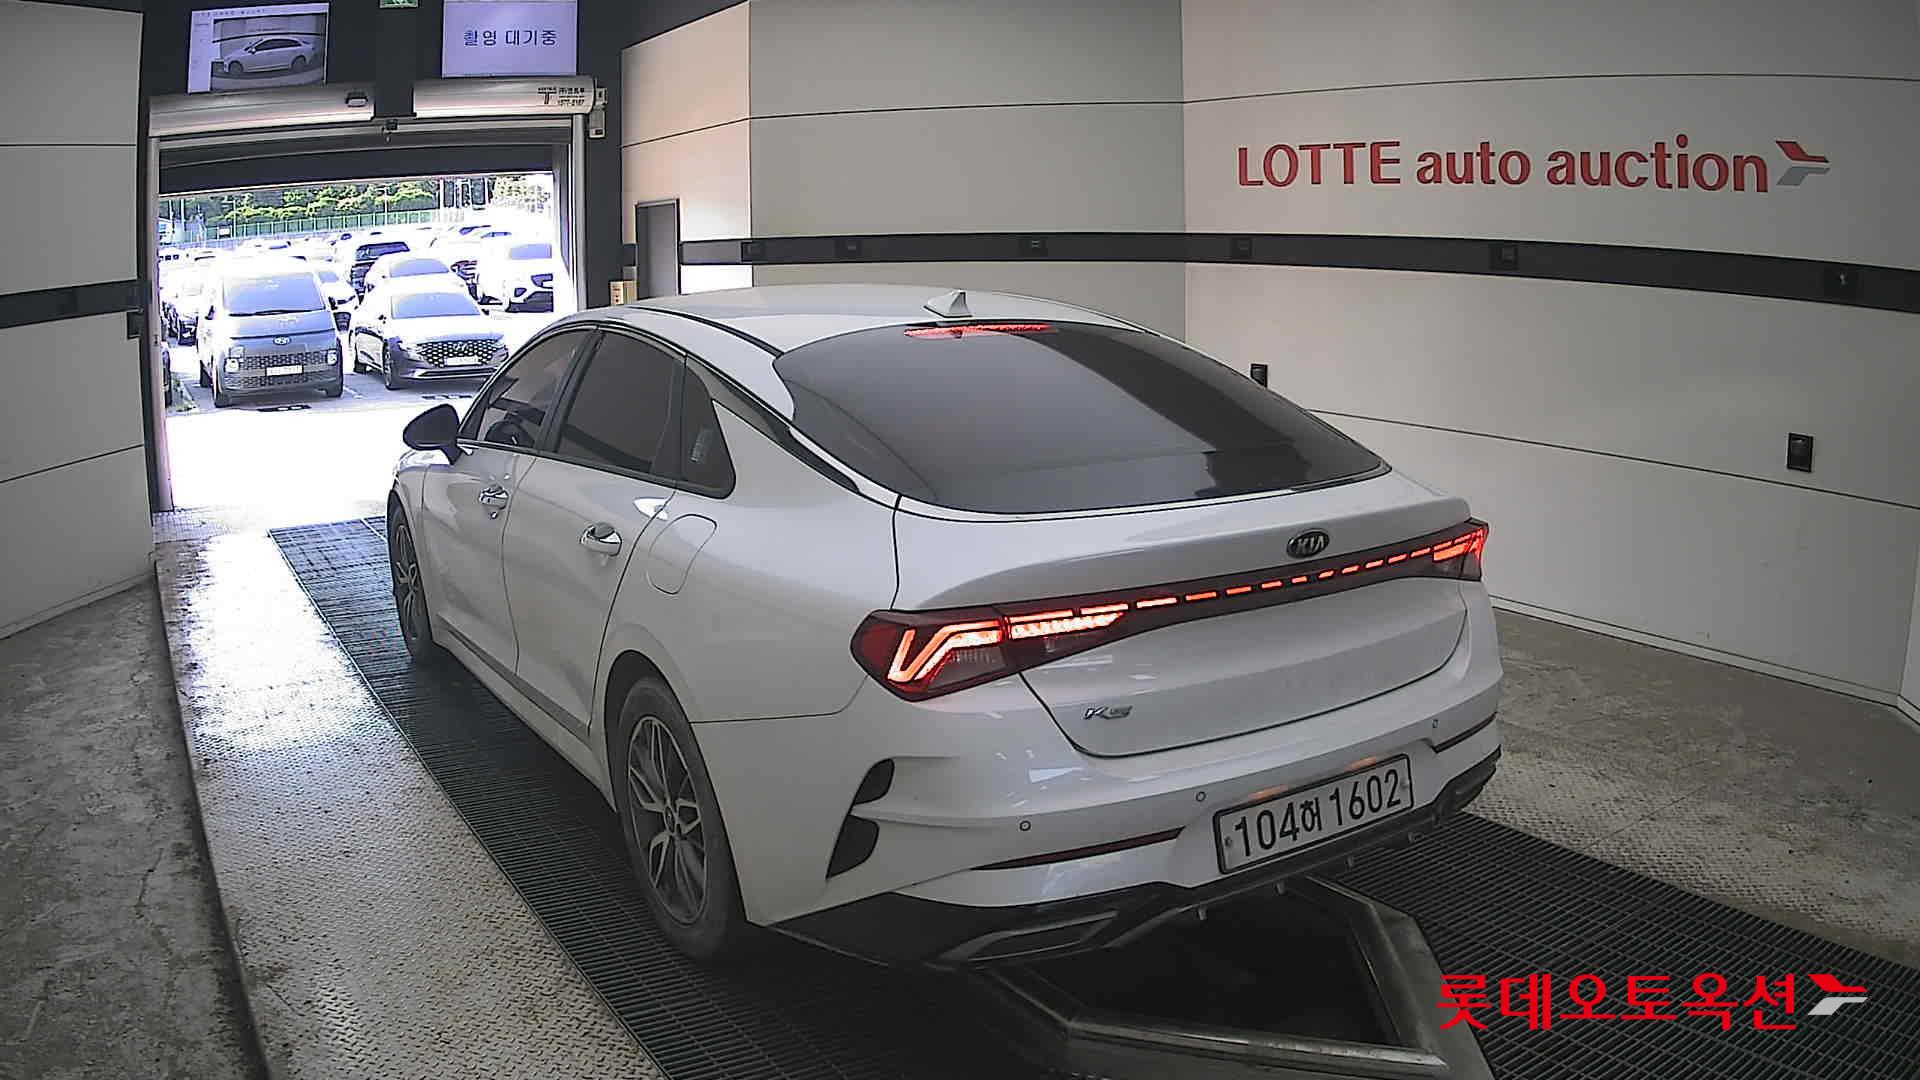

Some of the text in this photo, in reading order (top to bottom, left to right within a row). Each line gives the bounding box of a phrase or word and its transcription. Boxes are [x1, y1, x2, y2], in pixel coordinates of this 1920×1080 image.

[504, 28, 558, 47] 대기중
[1237, 134, 1770, 193] LOTTE auto auction
[1234, 768, 1401, 858] 104허 1602
